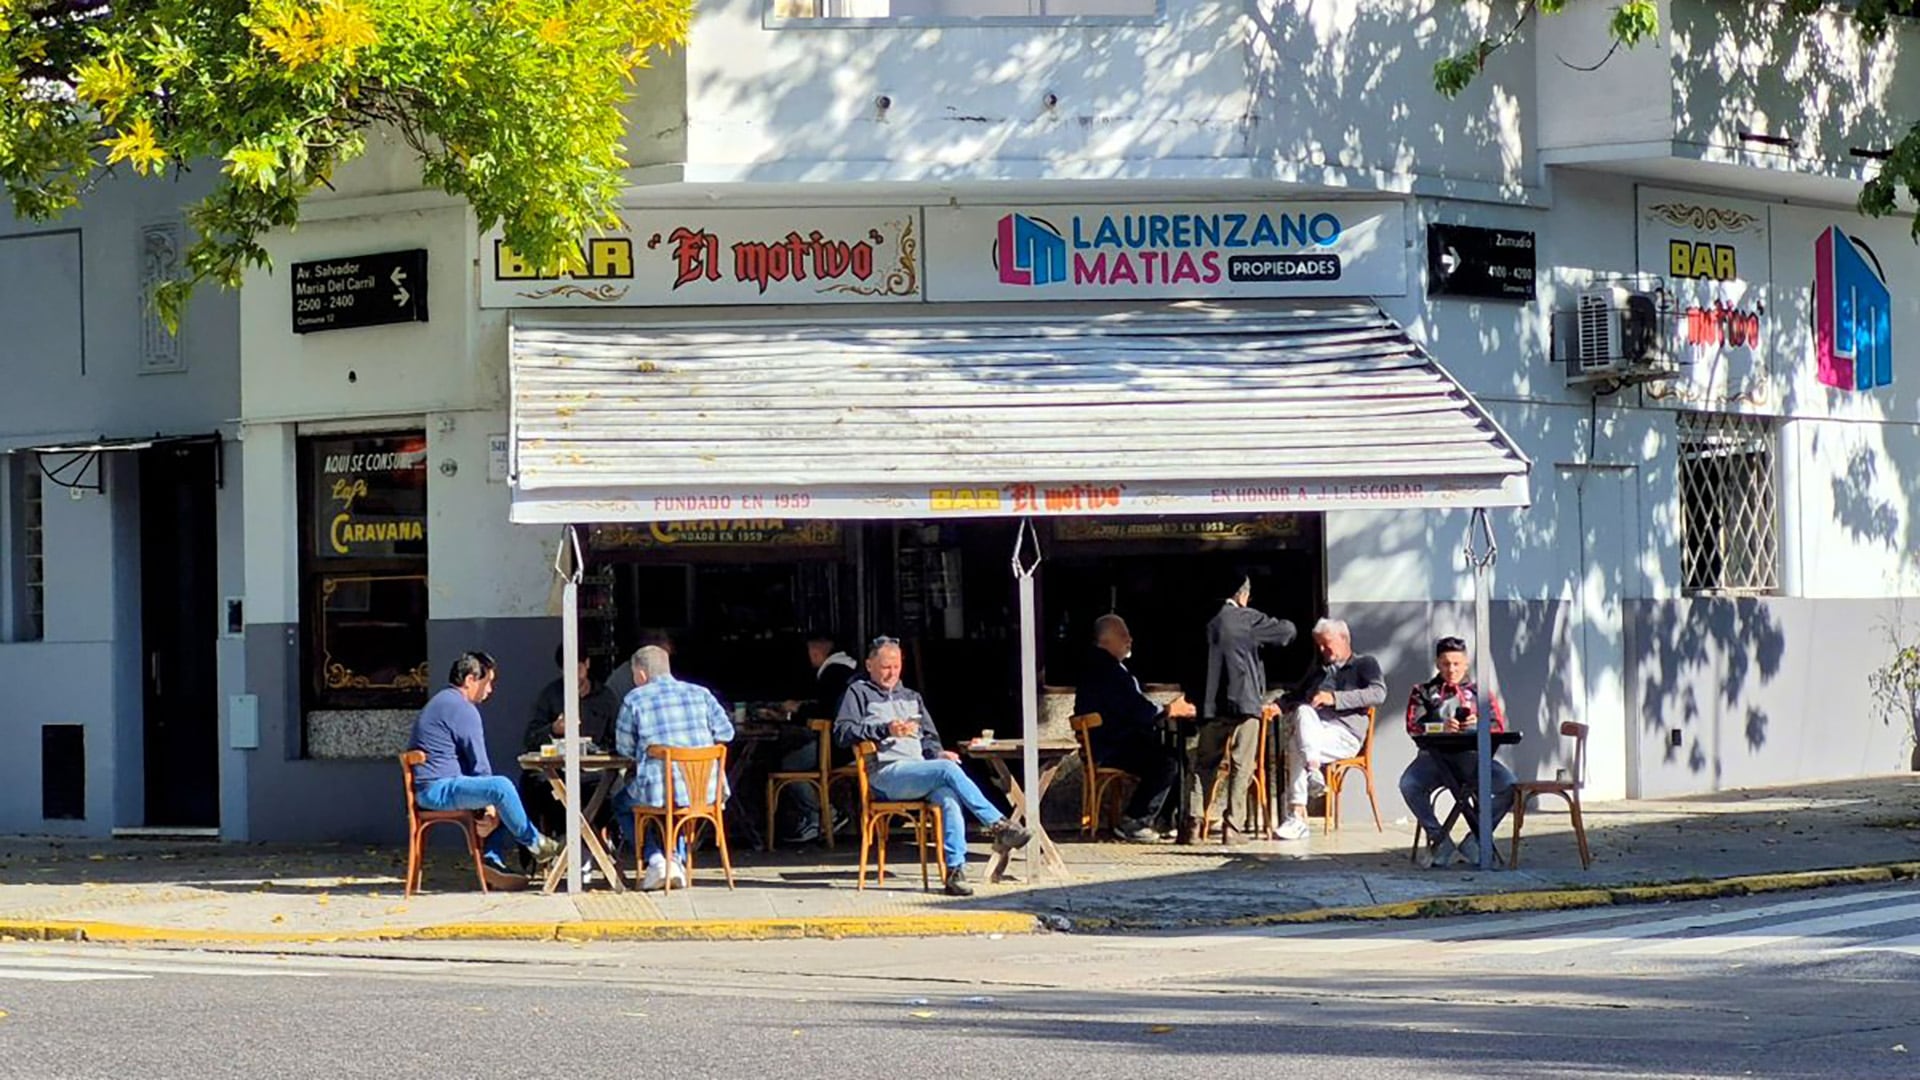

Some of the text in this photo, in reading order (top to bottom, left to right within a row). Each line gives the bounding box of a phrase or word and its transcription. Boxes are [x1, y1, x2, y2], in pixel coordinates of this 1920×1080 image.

[1073, 213, 1341, 249] LAURENZANO
[1074, 251, 1335, 285] MATIAS PROPIEDADES
[1669, 239, 1737, 281] BAR
[297, 262, 359, 280] Av. Salvador
[328, 279, 345, 293] Del
[347, 276, 375, 290] Carril
[297, 297, 321, 312] 2500
[330, 294, 354, 308] 2400
[324, 455, 350, 473] AQUI
[350, 454, 365, 471] SE
[655, 493, 811, 511] FUNDADO EN 1959
[930, 488, 999, 511] BAR
[1211, 488, 1230, 502] EN
[1236, 487, 1290, 501] HONOR
[1298, 486, 1307, 500] A
[1350, 484, 1424, 500] ESCOBAR
[331, 514, 423, 553] CARAVANA
